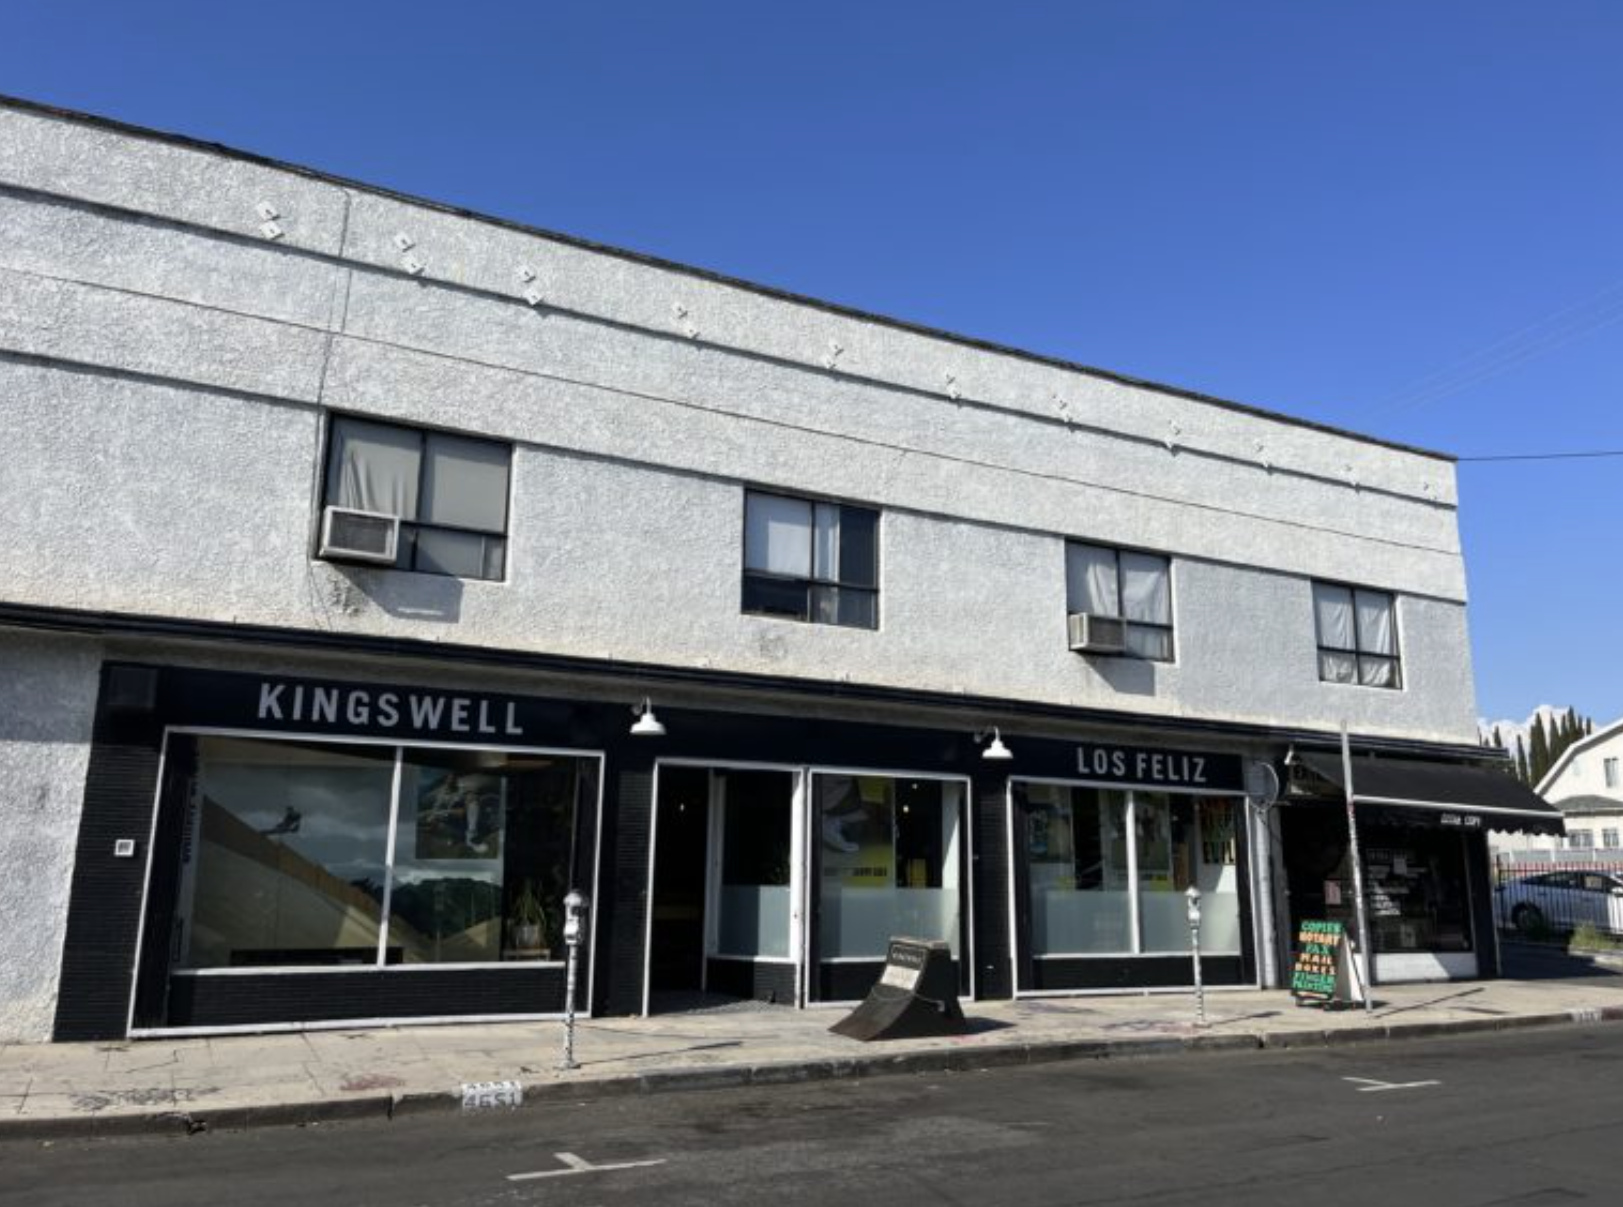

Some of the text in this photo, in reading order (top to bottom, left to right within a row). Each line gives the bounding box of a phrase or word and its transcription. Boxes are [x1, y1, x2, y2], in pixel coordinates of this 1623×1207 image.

[258, 683, 524, 734] KINGSWELL
[1077, 747, 1207, 782] LOS FELIZ
[1301, 921, 1342, 933] COPIES
[1299, 932, 1340, 946] NOTARY
[1305, 944, 1329, 954] FAX
[1300, 953, 1332, 964] MAIL
